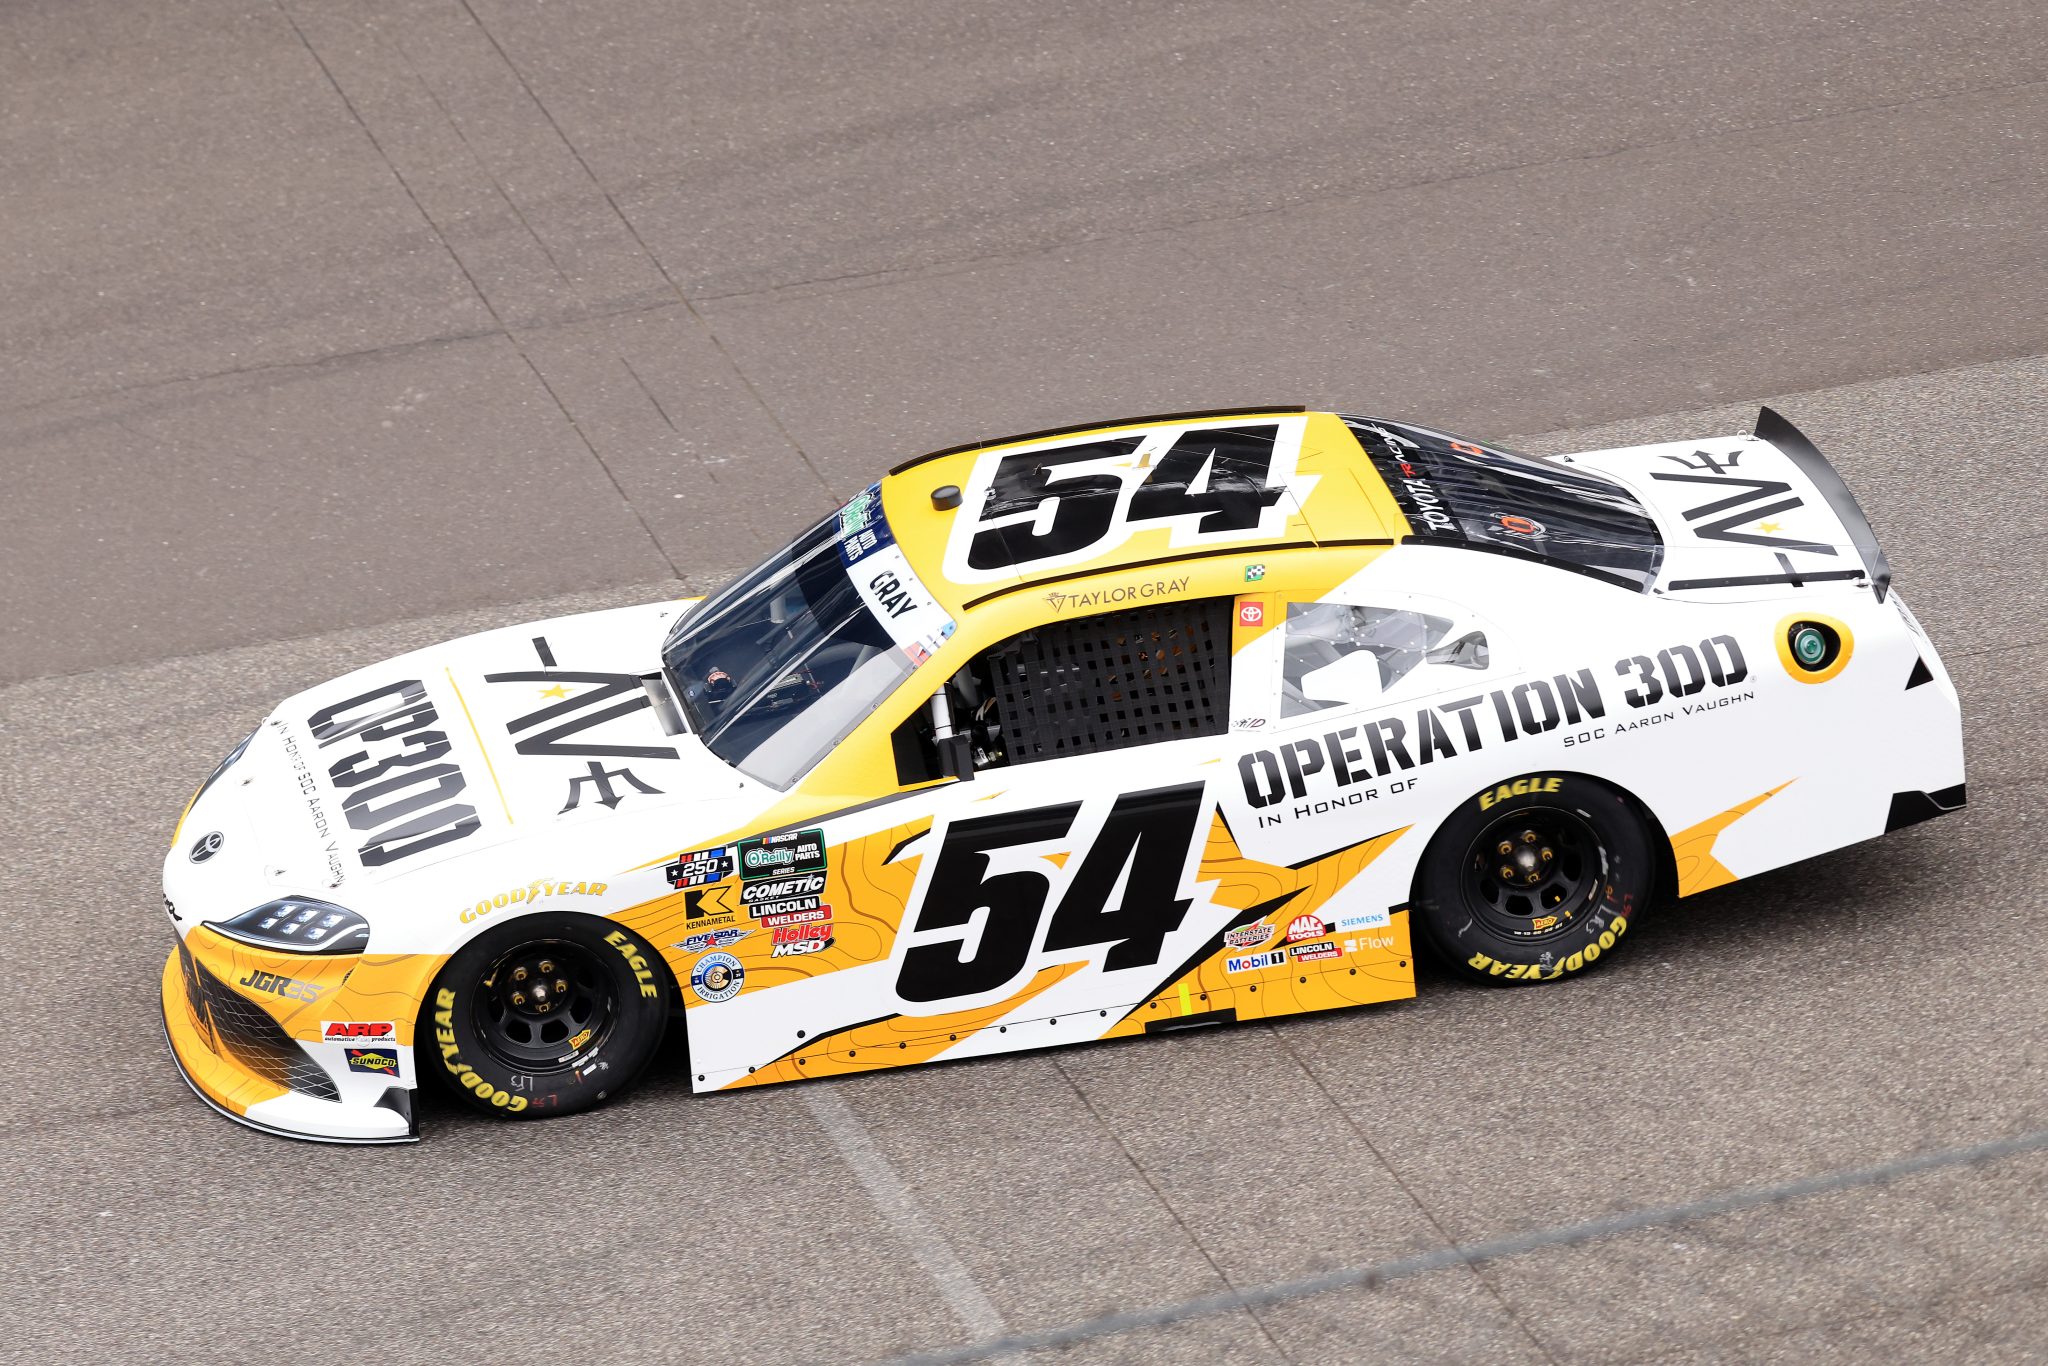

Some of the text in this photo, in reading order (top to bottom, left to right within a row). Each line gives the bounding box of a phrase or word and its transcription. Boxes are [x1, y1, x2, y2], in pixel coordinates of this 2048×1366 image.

[967, 424, 1287, 570] 54
[1402, 479, 1459, 532] TOYOTA
[843, 536, 864, 561] PARTS
[858, 529, 878, 550] AUTO
[869, 570, 918, 619] GRAY
[1068, 576, 1190, 609] TAYLOR GRAY
[1238, 634, 1749, 809] OPERATION 300
[1258, 691, 1755, 829] IN HONOR OF SOC AARON VAUGHN
[307, 679, 482, 867] OP300
[298, 772, 317, 796] SOC
[1478, 777, 1564, 812] EAGLE
[307, 797, 332, 839] AARON
[772, 832, 798, 843] NASCAR
[747, 849, 793, 866] O'Reilly
[795, 850, 821, 861] PARTS
[797, 843, 818, 854] AUTO
[325, 840, 347, 886] VAUGHN
[682, 859, 718, 878] 250
[772, 867, 796, 876] SERIES
[742, 876, 825, 900] COMETIC
[895, 780, 1206, 1003] 54
[459, 878, 608, 924] GOODYEAR
[752, 898, 817, 917] LINCOLN
[686, 916, 736, 930] KENNAMETAL
[768, 910, 825, 926] WELDERS
[1288, 915, 1323, 935] MAC
[1341, 913, 1384, 927] SIEMENS
[686, 933, 711, 946] FIVE
[714, 929, 738, 939] STAR
[772, 923, 834, 945] Holley
[1227, 926, 1272, 939] INTERSTATE
[1229, 933, 1270, 945] BATTERIES
[1288, 929, 1325, 941] TOOLS
[771, 939, 826, 958] MSD
[1291, 942, 1333, 956] LINCOLN
[1359, 935, 1395, 951] Flow
[1467, 916, 1627, 981] GOODYEAR
[603, 930, 658, 999] EAGLE
[695, 954, 738, 973] CHAMPION
[1228, 953, 1269, 972] Mobil
[1301, 950, 1339, 962] WELDERS
[696, 980, 741, 1000] IRRIGATION
[325, 1023, 393, 1036] ARP
[434, 988, 528, 1112] GOODYEAR
[352, 1057, 395, 1067] SUNOCO
